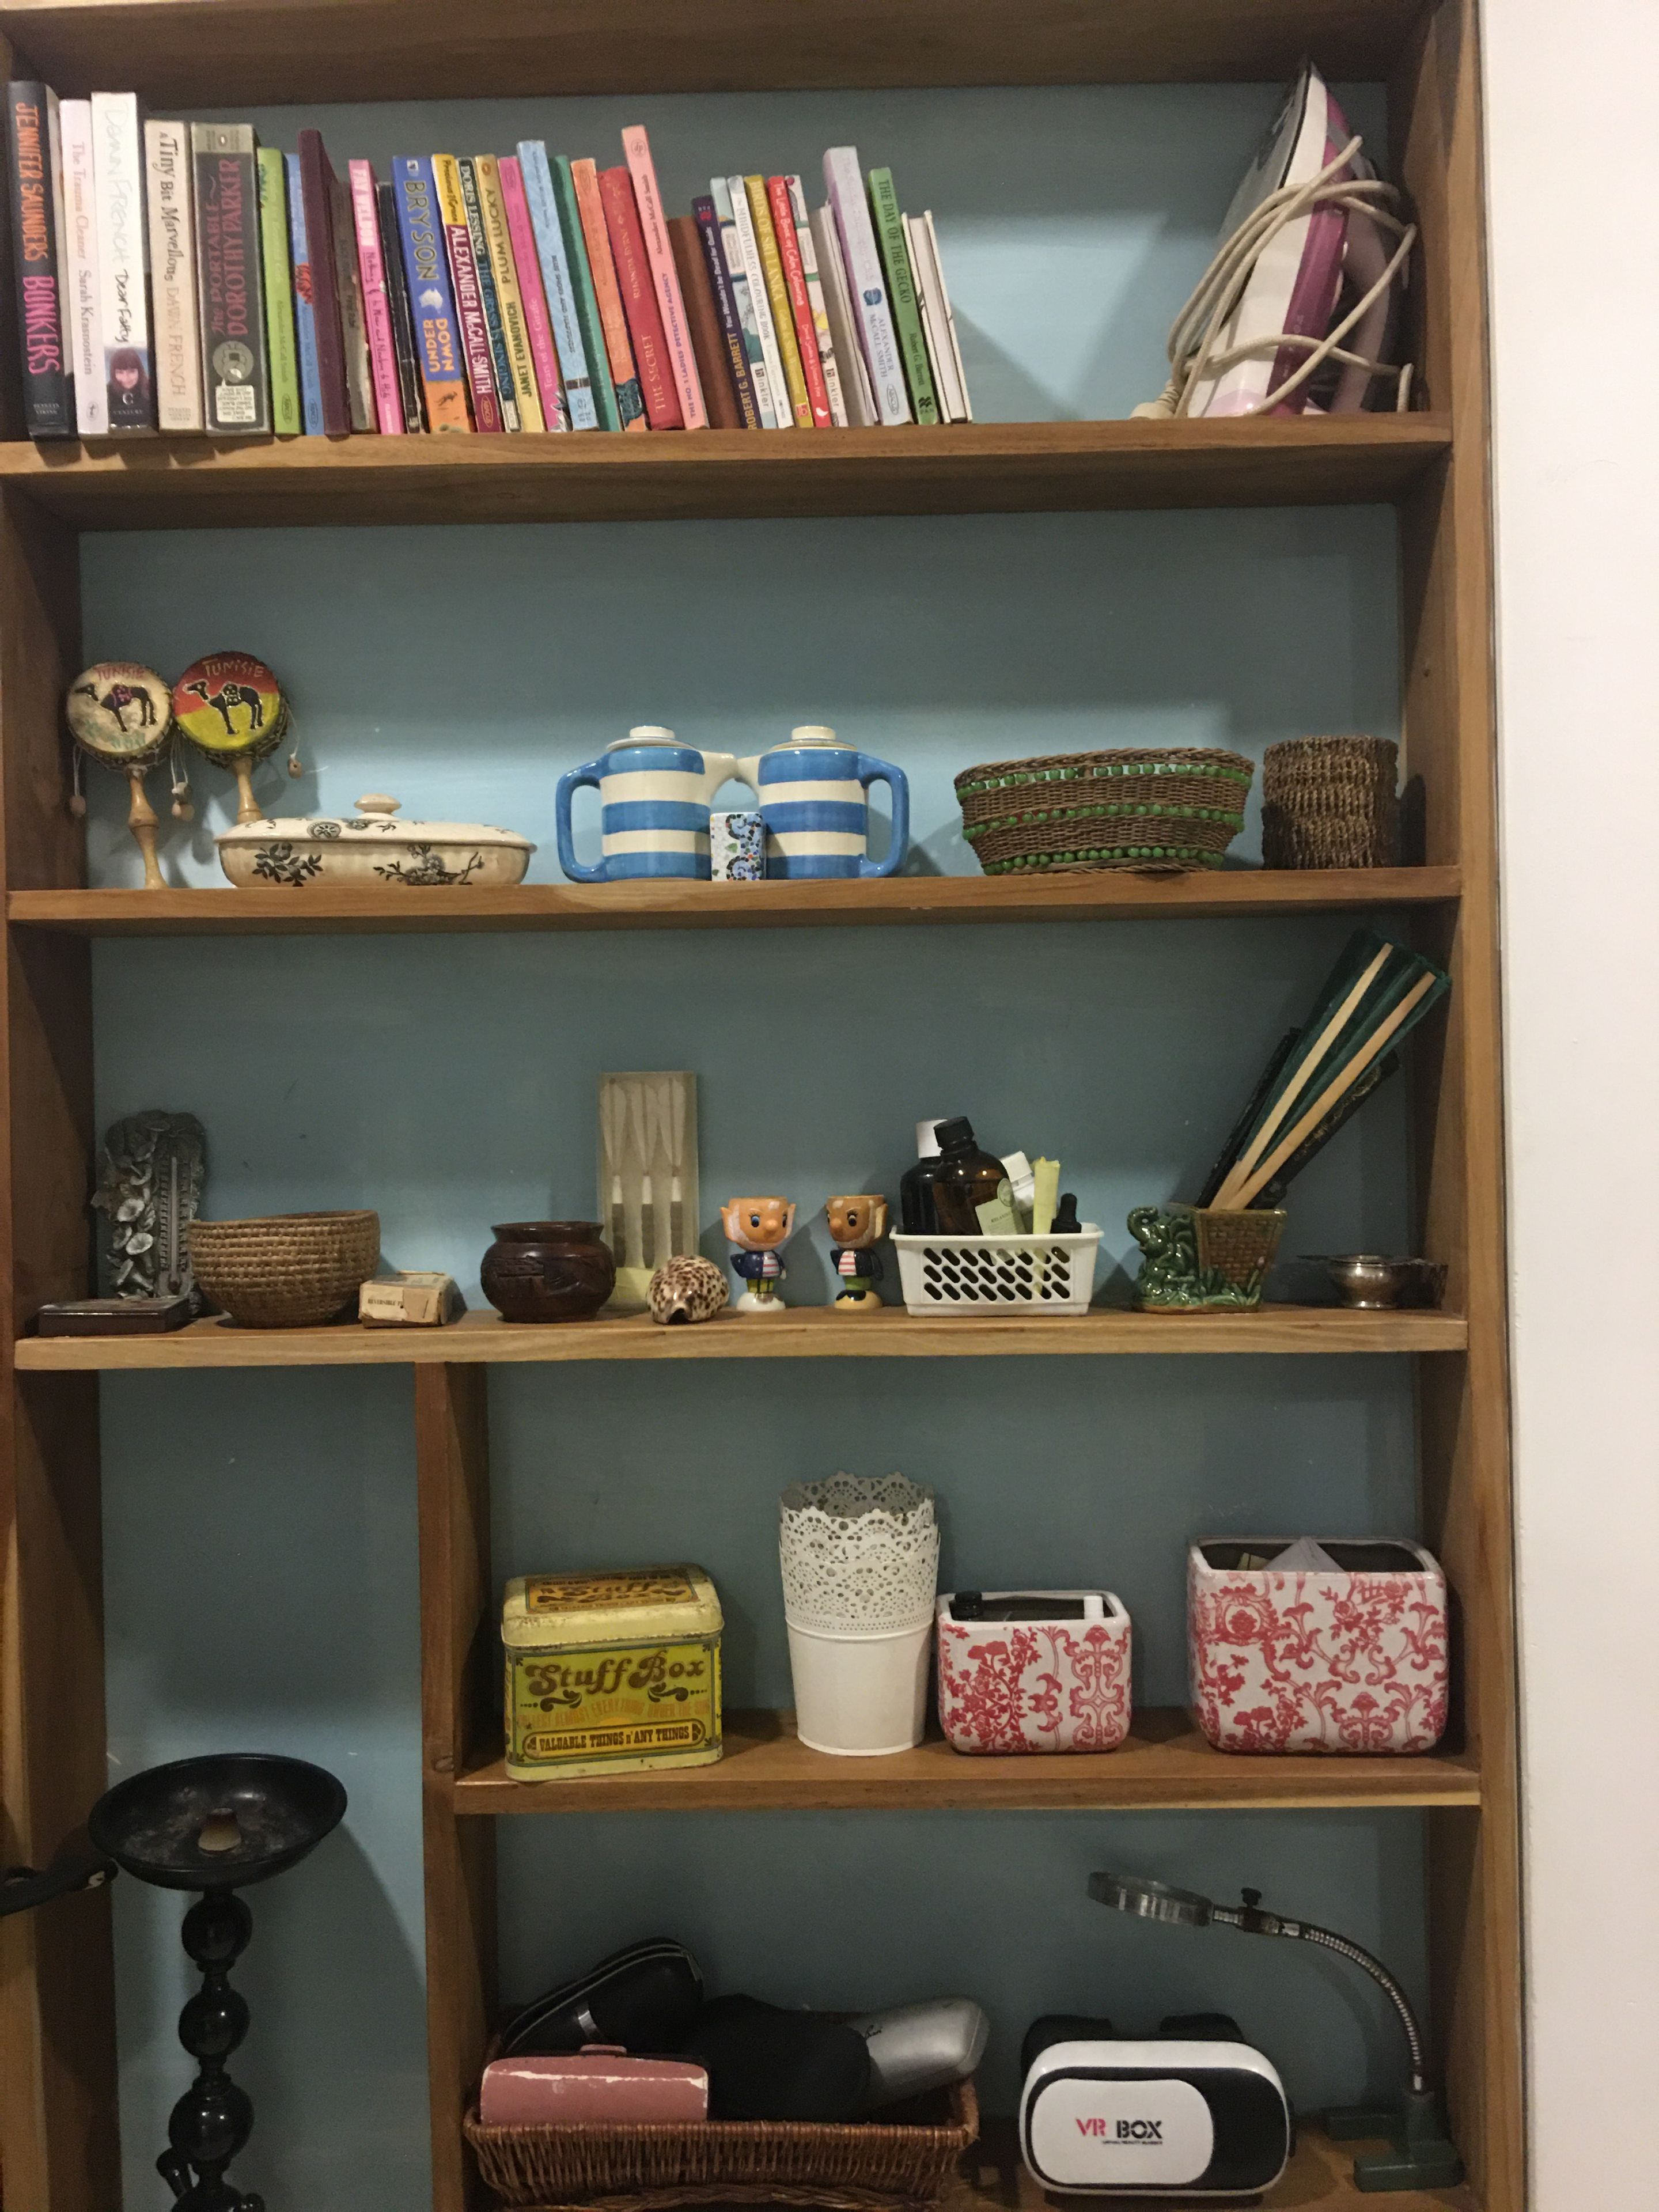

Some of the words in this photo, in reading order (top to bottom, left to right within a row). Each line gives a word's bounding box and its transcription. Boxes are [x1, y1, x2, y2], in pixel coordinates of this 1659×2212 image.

[14, 101, 43, 179] JENNIFER
[71, 142, 85, 164] The
[150, 138, 179, 178] Tiny
[73, 169, 88, 211] Trauma
[159, 180, 174, 201] Bit
[218, 158, 243, 231] PARKER
[352, 169, 368, 193] FAY
[441, 160, 456, 194] Precious
[459, 165, 476, 204] DORIS
[774, 180, 786, 196] The
[878, 179, 892, 200] THE
[484, 187, 503, 236] LUCKY
[645, 195, 657, 220] McCall
[748, 180, 768, 217] BIRDS
[774, 196, 789, 217] Little
[882, 203, 897, 223] DAY
[18, 182, 48, 262] SAUNDERS
[75, 215, 90, 259] Cleaner
[403, 181, 440, 281] BRYSON
[467, 206, 486, 255] LESSING
[650, 221, 665, 255] Alexander
[756, 218, 771, 233] OF
[779, 217, 793, 238] Book
[887, 226, 900, 240] OF
[160, 206, 185, 281] Marvellous
[204, 202, 224, 303] PORTABLE
[494, 241, 512, 283] PLUM
[760, 236, 776, 255] SRI
[783, 238, 794, 249] of
[785, 248, 799, 270] Calm
[890, 244, 905, 266] THE
[449, 227, 478, 307] ALEXANDER
[478, 262, 492, 287] THE
[625, 257, 642, 298] RHONDA
[710, 256, 722, 275] Dead
[736, 207, 757, 271] MINDFULNESS
[750, 272, 767, 320] COLOURING
[759, 320, 771, 340] BOOK
[764, 259, 785, 302] LANKA
[78, 270, 93, 302] Sarah
[113, 268, 132, 303] Dear
[222, 237, 249, 336] DOROTHY
[660, 271, 673, 304] AGENCY
[789, 269, 807, 306] Colouring
[895, 267, 912, 304] GECKO
[21, 275, 60, 374] BONKERS
[113, 308, 133, 344] Fatty
[165, 287, 181, 331] DAWN
[482, 289, 499, 328] GRASS
[528, 297, 544, 331] Giraffe
[666, 305, 682, 347] DETECTIVE
[724, 315, 733, 328] You
[80, 306, 97, 374] Krasnostein
[422, 319, 441, 372] UNDER
[434, 318, 454, 371] DOWN
[505, 301, 526, 359] EVANOVICH
[534, 334, 547, 349] the
[868, 313, 882, 347] McCALL
[875, 349, 889, 377] SMITH
[877, 317, 895, 372] ALEXANDER
[908, 332, 921, 354] Robert
[168, 334, 185, 396] FRENCH
[493, 344, 512, 395] SINGING
[537, 351, 550, 362] of
[639, 333, 661, 381] SECRET
[726, 331, 747, 377] BARRETT
[517, 364, 532, 396] JANET
[540, 365, 555, 391] Tears
[753, 368, 771, 407] hinkler
[824, 368, 842, 407] hinkler
[650, 385, 667, 412] THE
[687, 401, 698, 418] THE
[739, 391, 759, 429] ROBERT
[525, 1658, 632, 1696] Stuff
[628, 1649, 704, 1688] Box
[539, 1736, 586, 1752] VALUABLE
[589, 1733, 624, 1749] THINGS
[634, 1729, 653, 1744] ANY
[656, 1725, 690, 1742] THINGS
[1076, 2119, 1106, 2136] VR
[1116, 2120, 1162, 2139] BOX
